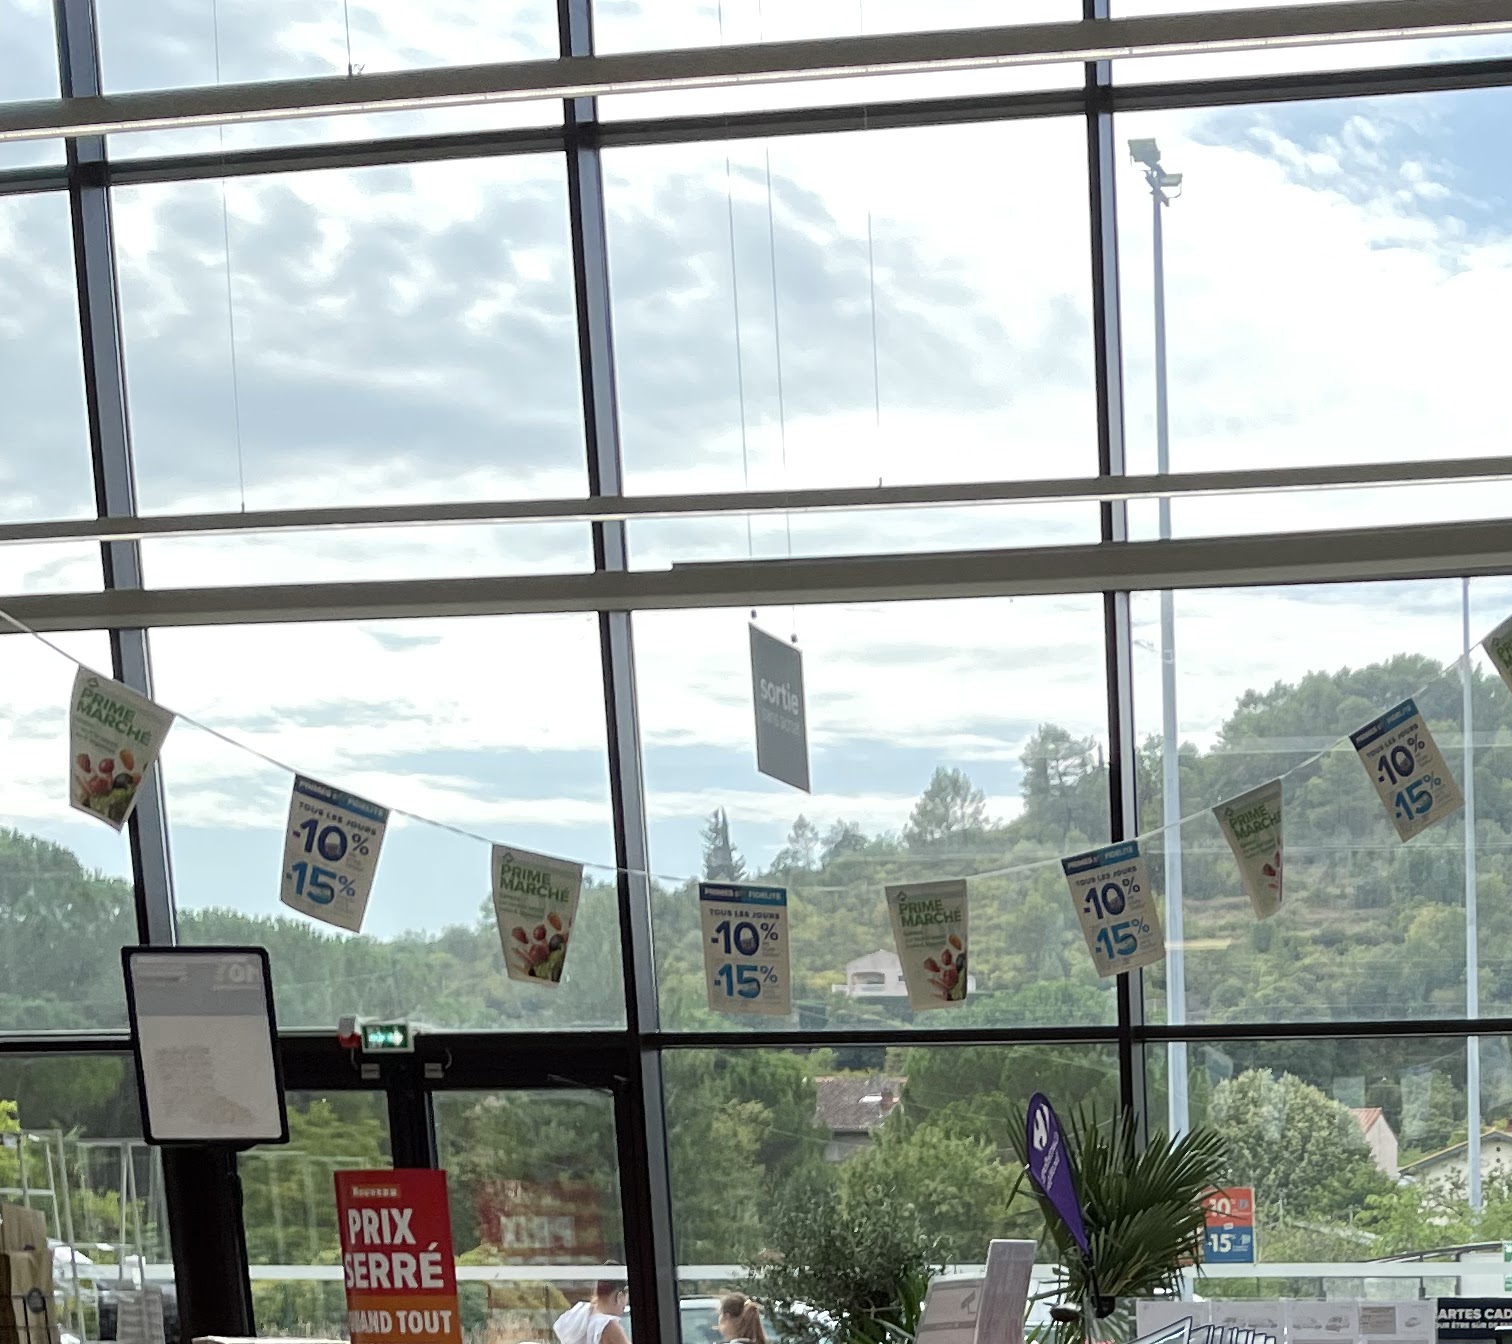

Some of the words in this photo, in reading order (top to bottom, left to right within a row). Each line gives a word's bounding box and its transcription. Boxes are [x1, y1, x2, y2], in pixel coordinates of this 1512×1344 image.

[80, 687, 136, 722] PRIME
[760, 678, 799, 716] sortie
[77, 700, 153, 747] MARCHÉ
[1378, 733, 1426, 785] -10%
[1395, 771, 1442, 821] -15%
[1229, 803, 1269, 829] PRIME
[292, 817, 370, 862] -10%
[285, 861, 357, 905] -15%
[500, 863, 552, 886] PRIME
[500, 876, 570, 903] MARCHÉ
[709, 908, 732, 917] TOUS
[734, 909, 750, 918] LES
[752, 911, 781, 920] JOURS
[898, 899, 944, 916] PRIME
[1083, 876, 1141, 920] -10%
[901, 906, 962, 928] MARCHÉ
[710, 920, 779, 956] -10%
[1095, 916, 1150, 960] -15%
[714, 963, 779, 999] -15%
[348, 1208, 417, 1245] PRIX
[344, 1242, 444, 1290] SERRÉ
[396, 1310, 452, 1334] TOUT
[1437, 1308, 1482, 1320] ARTES
